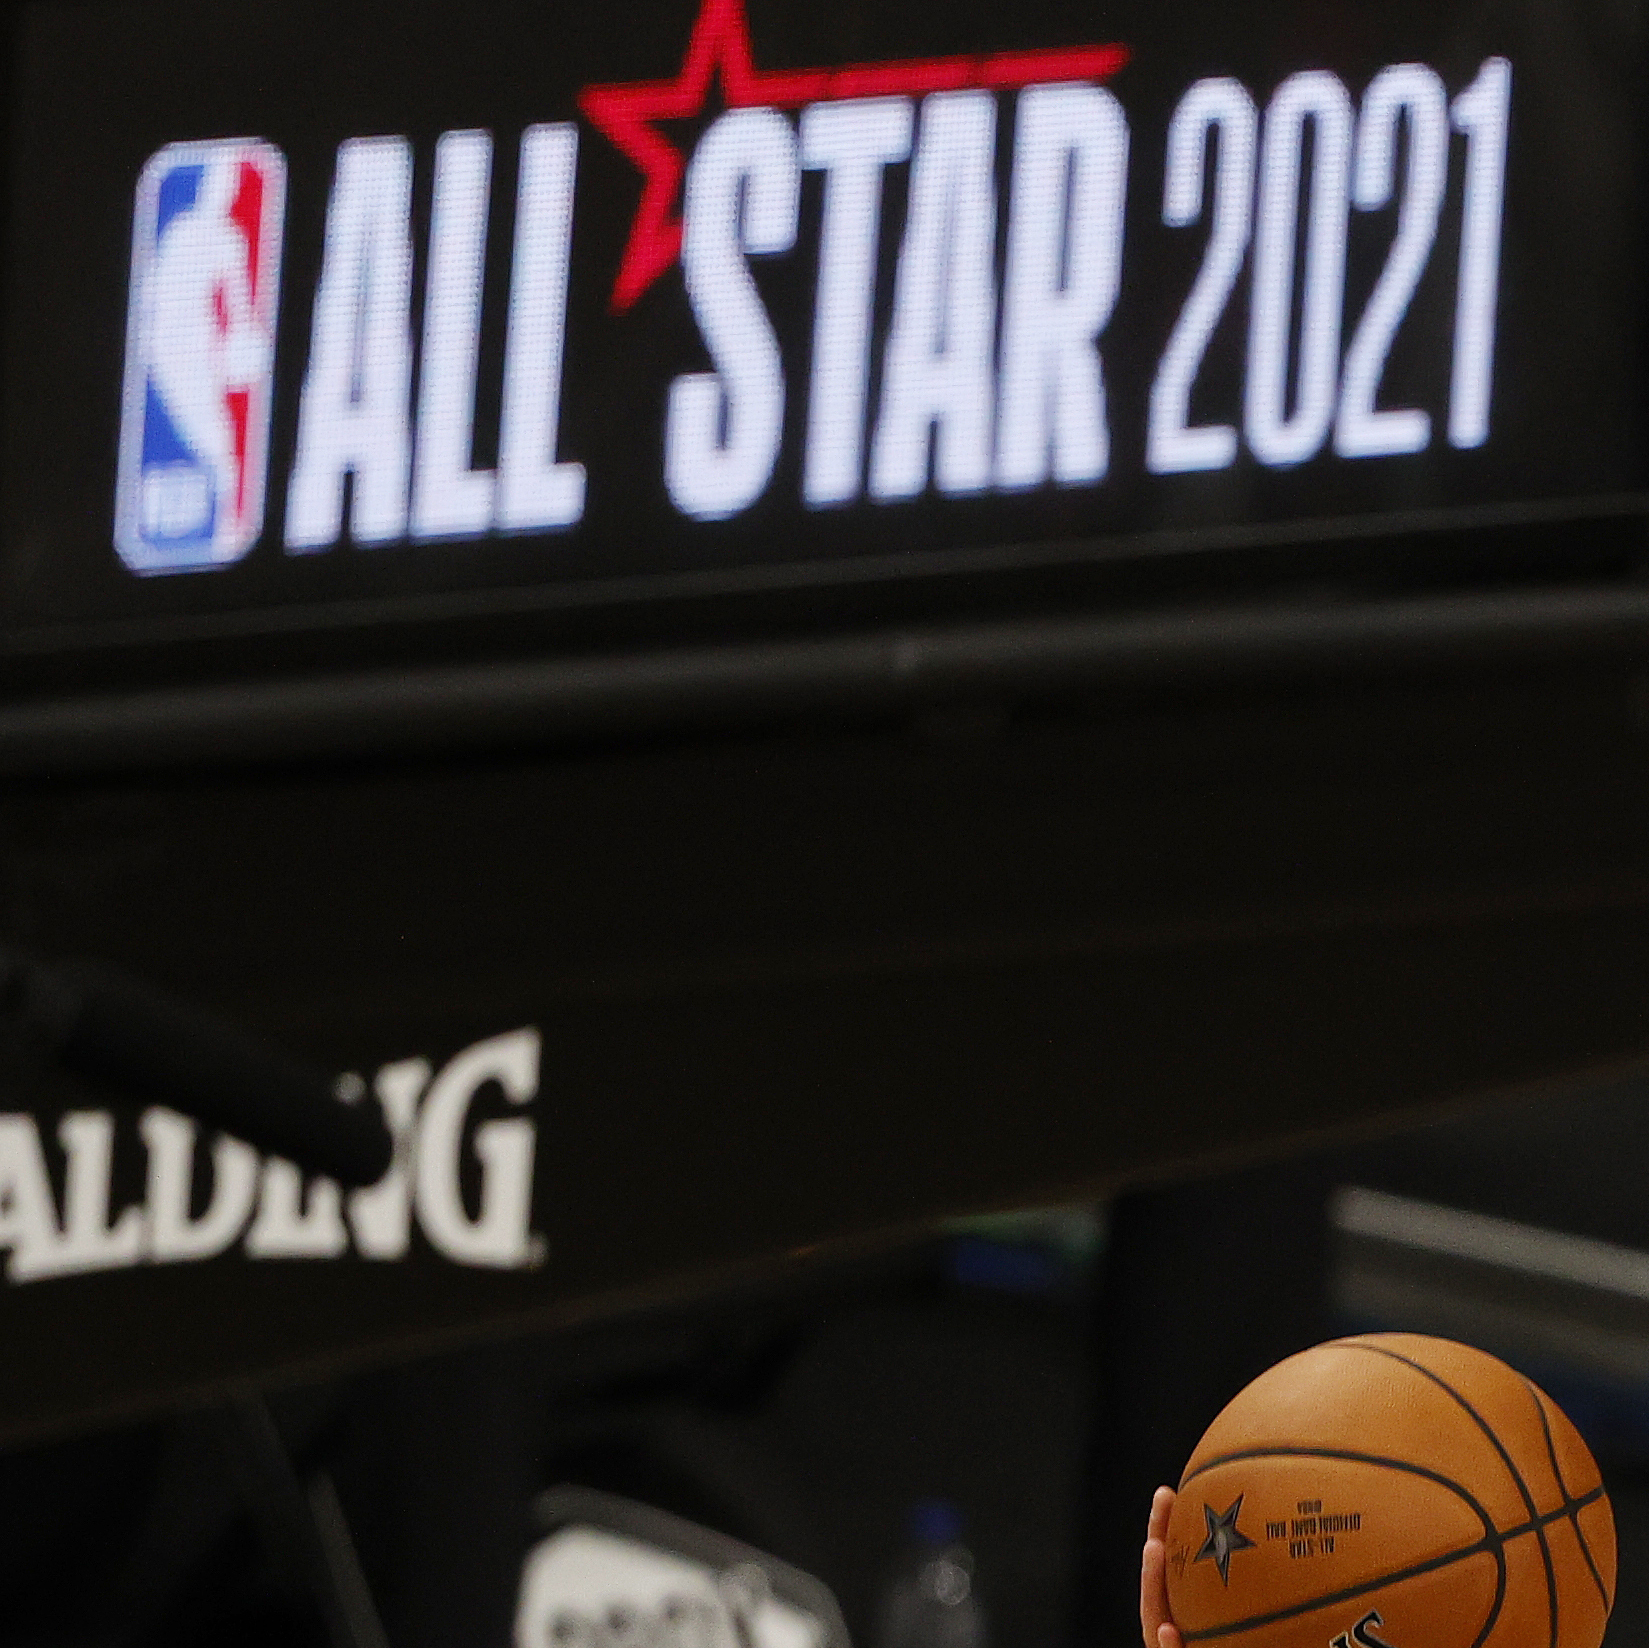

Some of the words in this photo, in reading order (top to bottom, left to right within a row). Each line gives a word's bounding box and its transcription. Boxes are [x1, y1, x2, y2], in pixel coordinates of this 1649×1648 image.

[284, 121, 587, 552] ALL
[663, 80, 1131, 521] STAR
[1146, 56, 1513, 474] 2021
